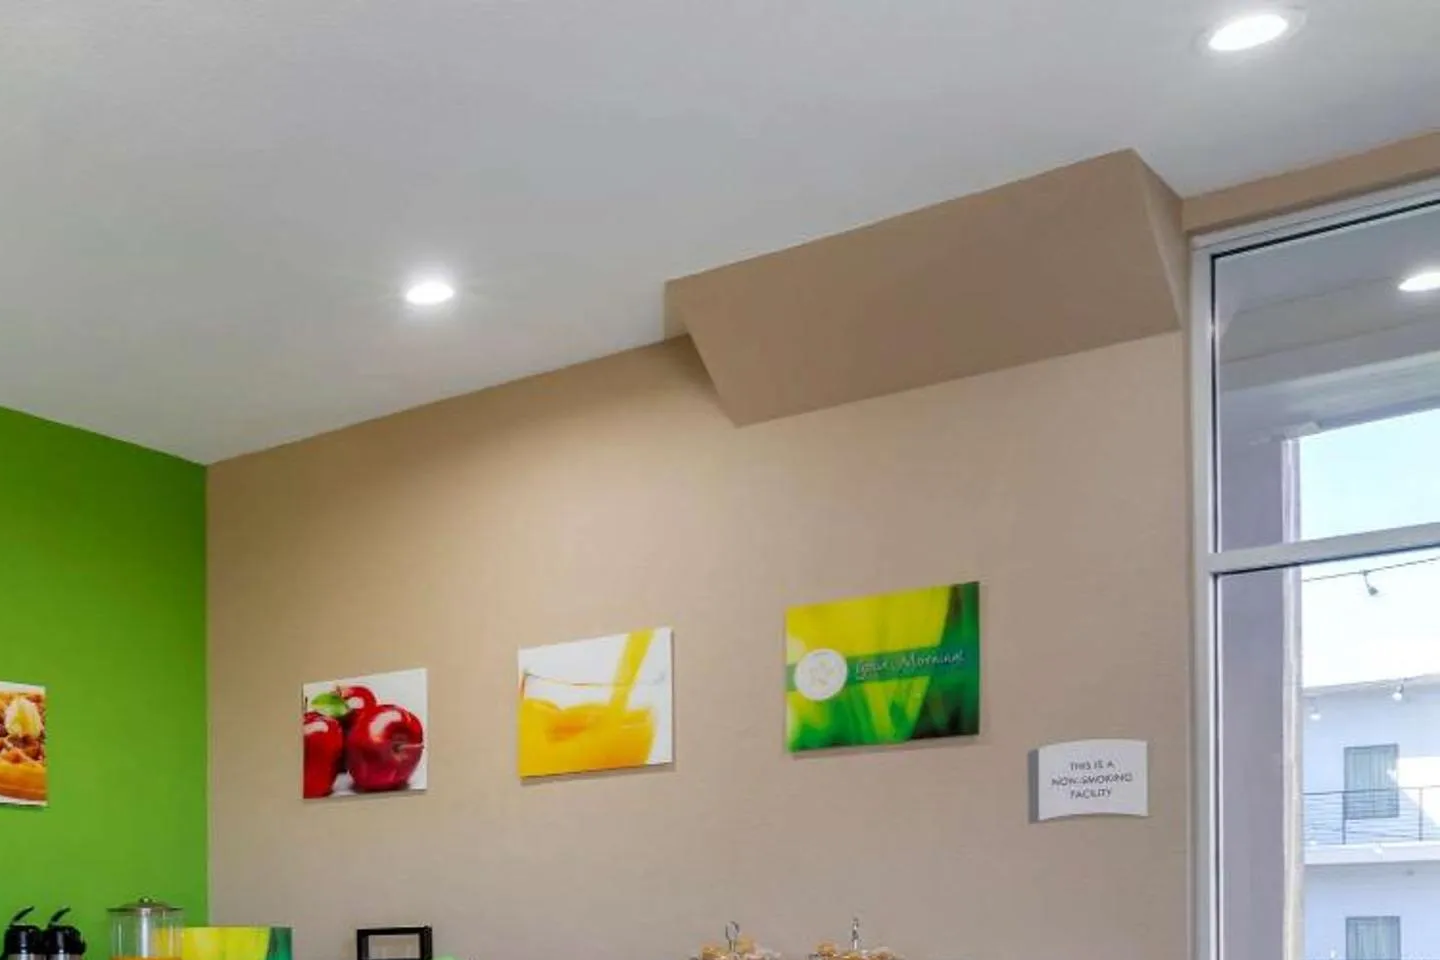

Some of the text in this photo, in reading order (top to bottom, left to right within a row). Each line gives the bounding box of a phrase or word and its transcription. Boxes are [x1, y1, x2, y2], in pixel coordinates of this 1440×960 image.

[1070, 760, 1115, 771] THIS IS A
[1051, 772, 1133, 786] NON-SMOKING
[1070, 788, 1112, 799] FACILITY
